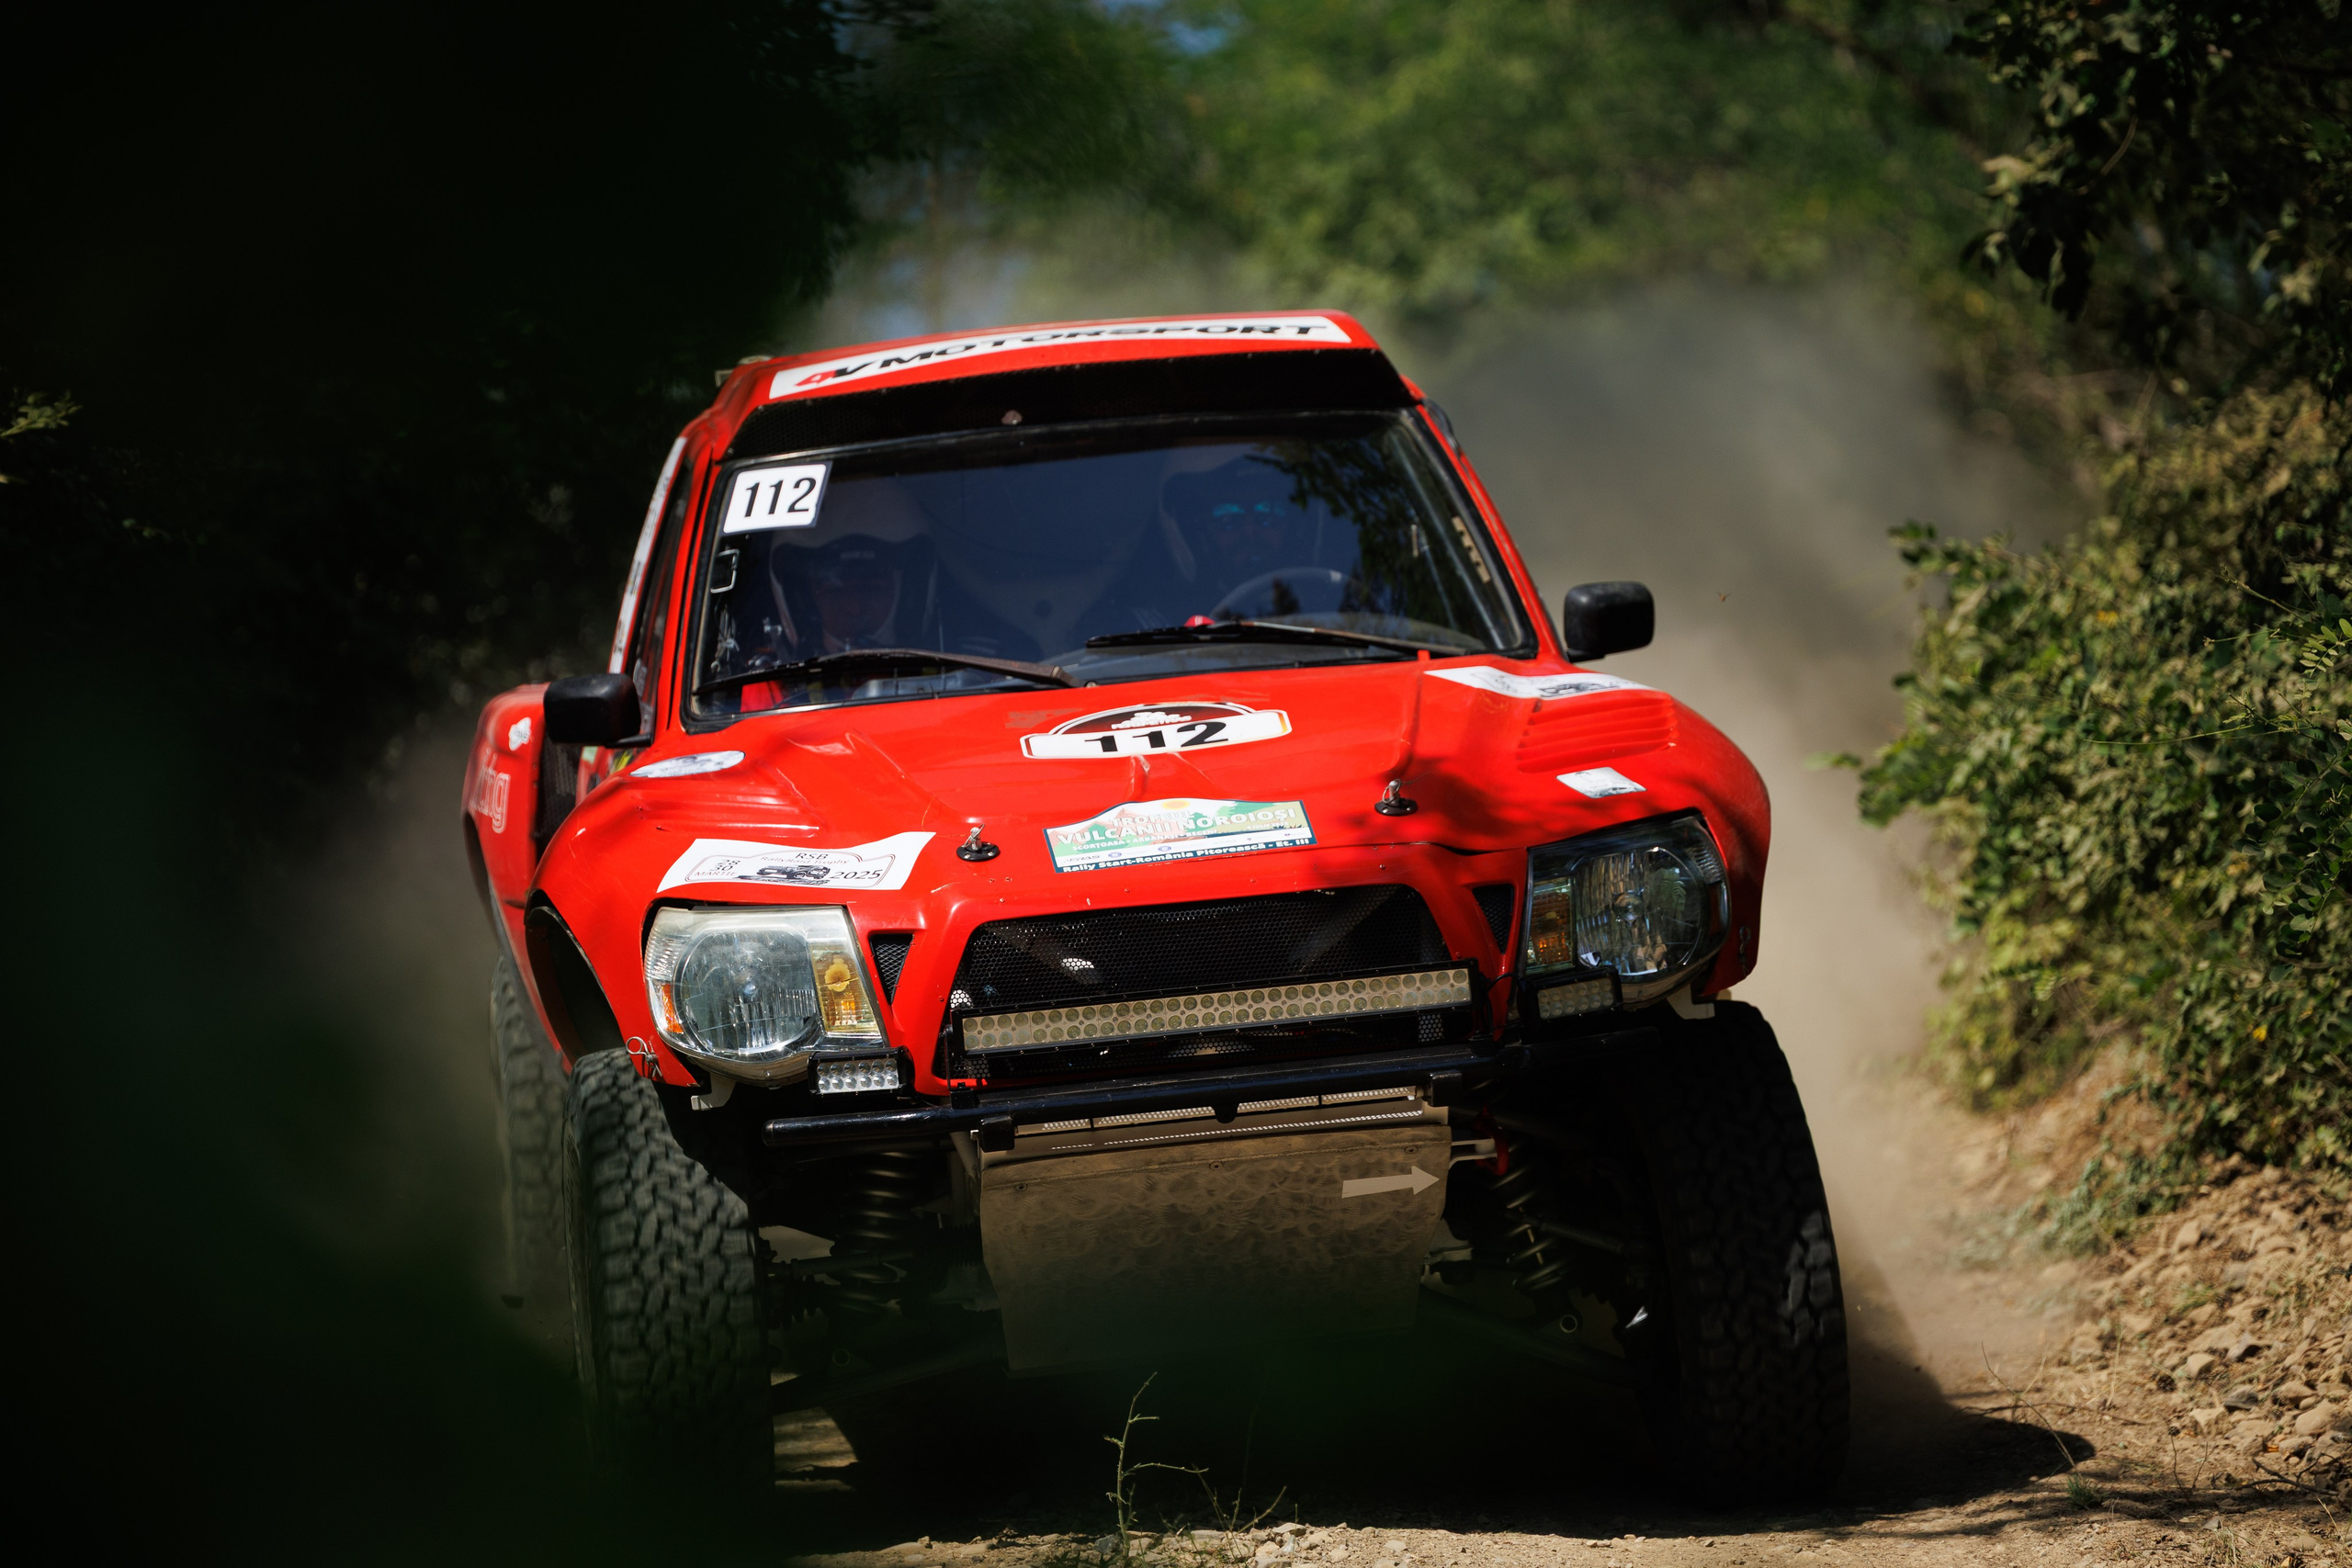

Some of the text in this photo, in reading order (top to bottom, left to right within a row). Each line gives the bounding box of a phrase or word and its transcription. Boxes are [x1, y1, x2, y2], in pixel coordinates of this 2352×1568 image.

[744, 477, 816, 518] 112
[1084, 721, 1228, 752] 112
[1109, 810, 1195, 828] TROFEUL
[1057, 822, 1172, 844] VULCANII
[1062, 863, 1096, 873] Rally
[1196, 842, 1266, 856] Pitorească
[829, 869, 883, 879] 2025
